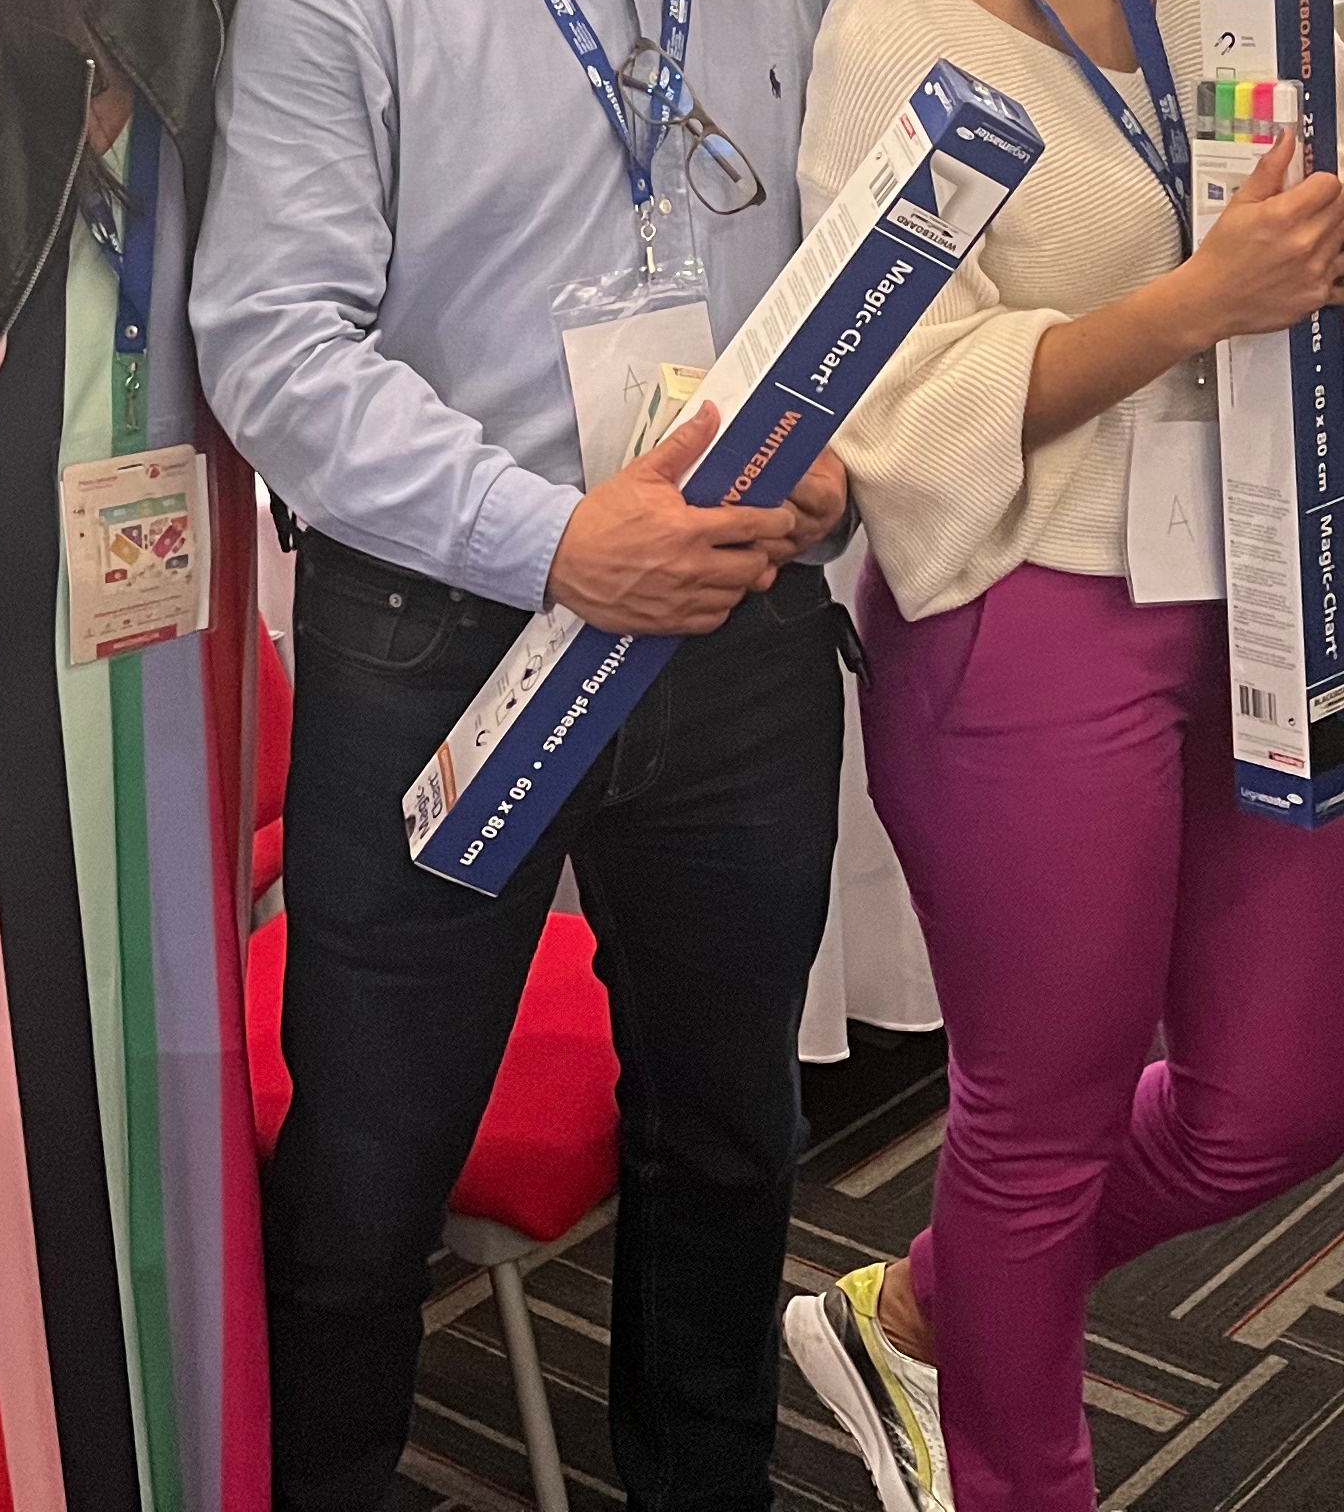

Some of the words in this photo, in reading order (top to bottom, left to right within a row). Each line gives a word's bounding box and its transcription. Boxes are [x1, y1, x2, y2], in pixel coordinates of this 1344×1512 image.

[1302, 112, 1316, 138] 25
[973, 126, 1031, 165] Legamaster
[896, 214, 957, 252] WHITEBOARD
[622, 364, 648, 403] A
[1314, 384, 1326, 410] 60
[1316, 414, 1324, 428] x
[720, 410, 803, 506] WHITEBOA
[1318, 462, 1327, 492] cm
[1166, 495, 1193, 542] A
[543, 695, 589, 753] sheets
[509, 777, 532, 800] 60
[498, 800, 513, 814] x
[481, 815, 505, 839] 80
[459, 840, 484, 866] cm
